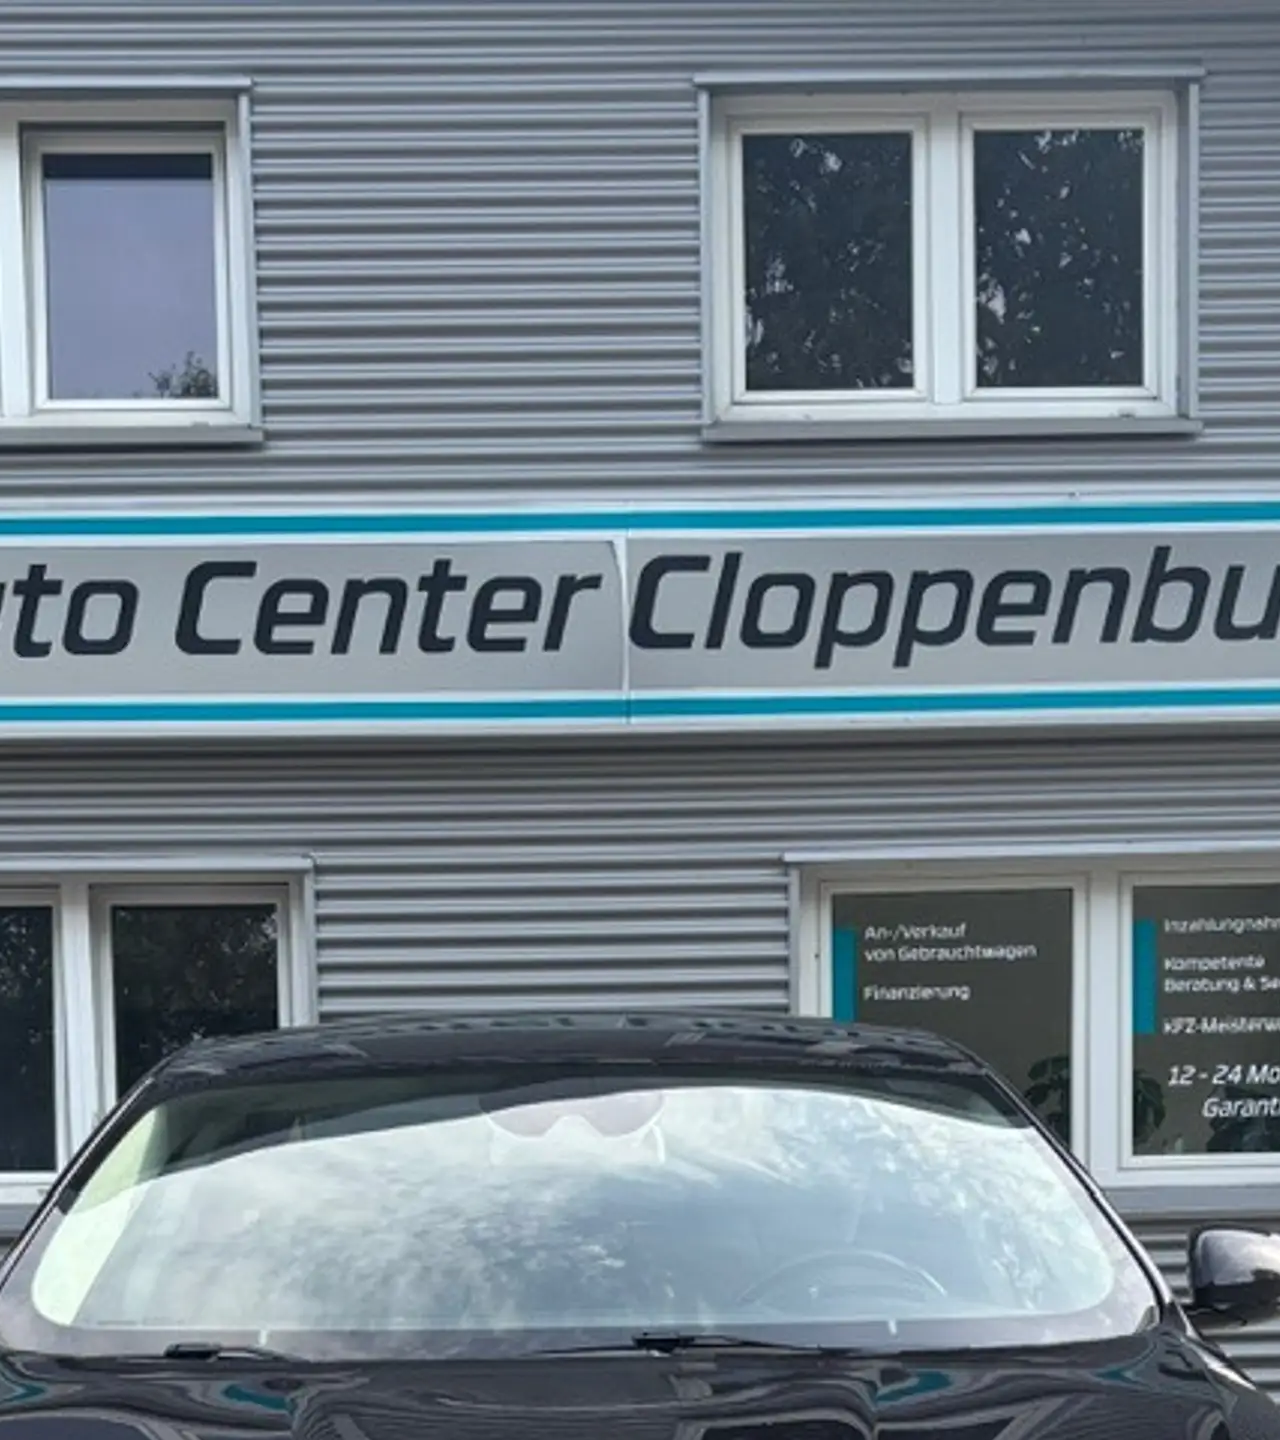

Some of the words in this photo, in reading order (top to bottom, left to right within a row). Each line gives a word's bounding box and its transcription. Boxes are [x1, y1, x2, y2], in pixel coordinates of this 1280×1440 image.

[174, 558, 602, 655] Center
[864, 948, 895, 962] von
[898, 944, 1037, 962] Gebrauchtwagen
[1164, 955, 1266, 971] Kompetente
[864, 984, 971, 1001] Finanzierung
[1164, 977, 1240, 993] Beratung
[1243, 976, 1256, 991] &
[1168, 1065, 1196, 1086] 12
[1212, 1064, 1242, 1085] 24
